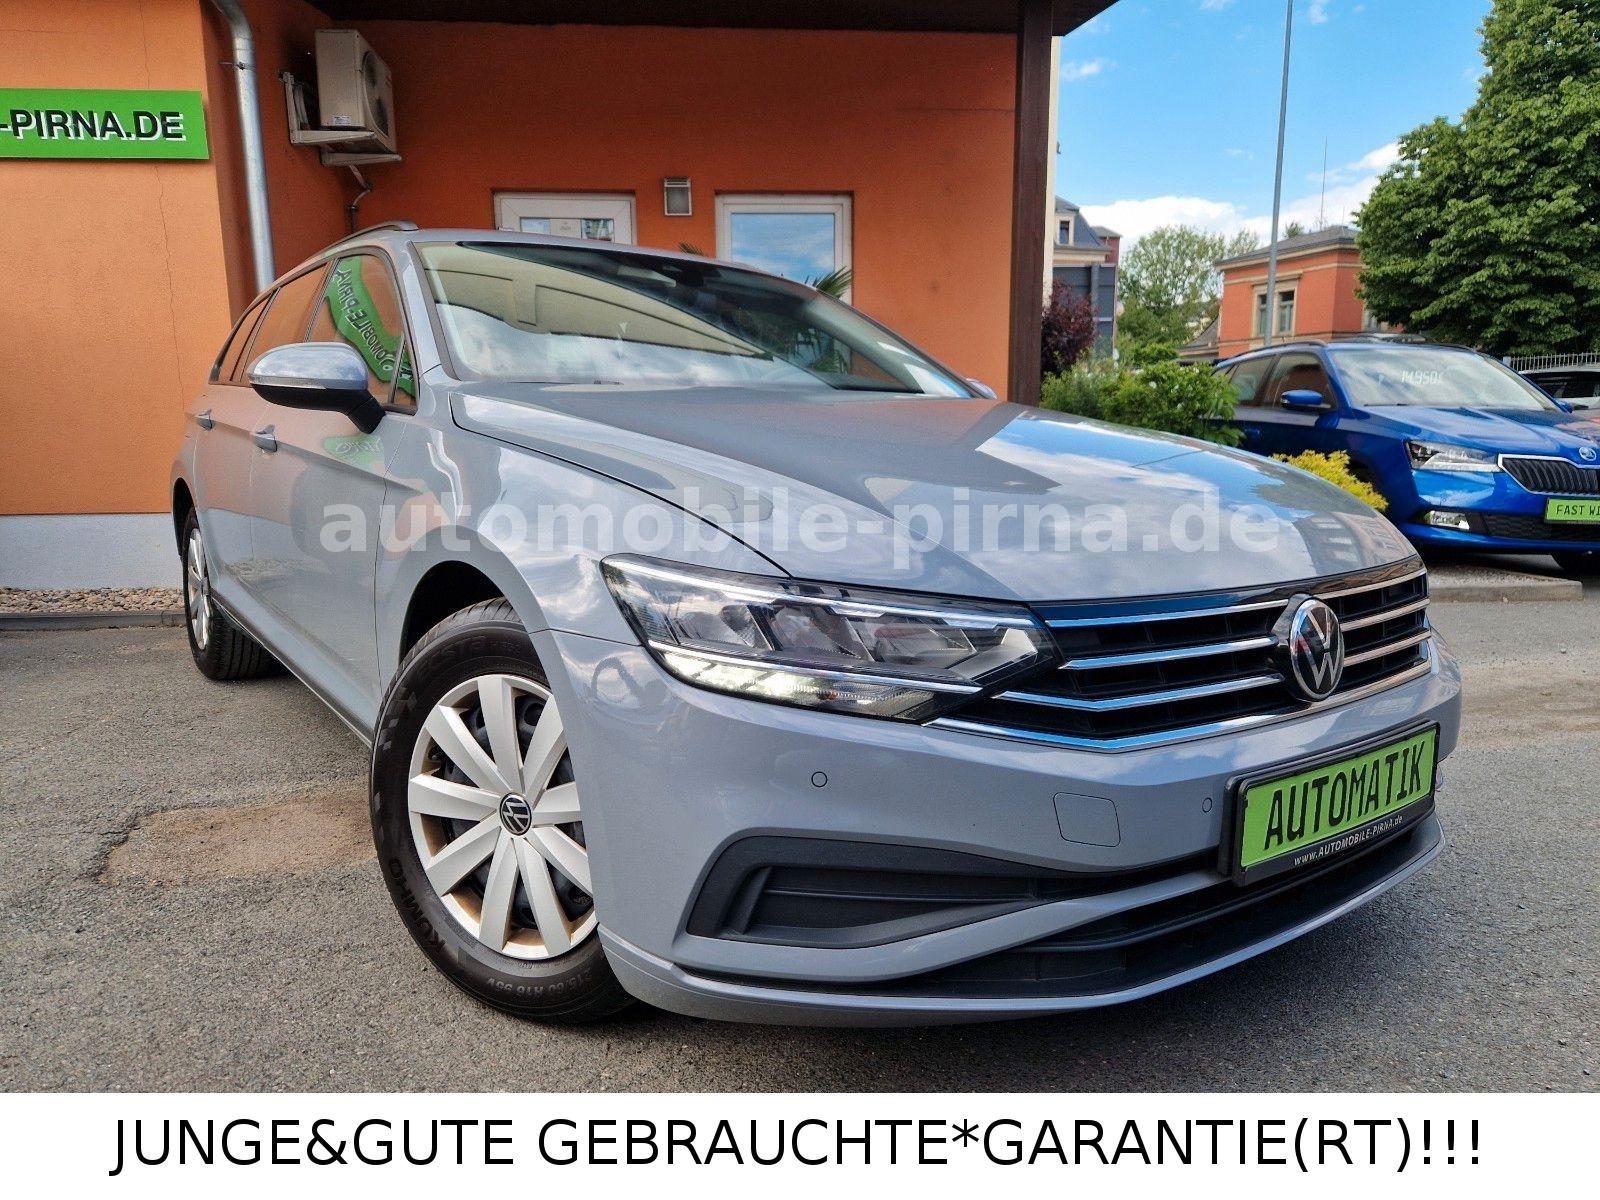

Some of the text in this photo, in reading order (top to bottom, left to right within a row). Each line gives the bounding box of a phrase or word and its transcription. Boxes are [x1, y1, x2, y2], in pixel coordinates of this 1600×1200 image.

[1556, 504, 1585, 515] FAST
[1264, 740, 1425, 850] AUTOMATIK
[1294, 814, 1403, 866] www.AUTOMOBILE-PIRNA.de
[388, 856, 447, 954] KUMHO
